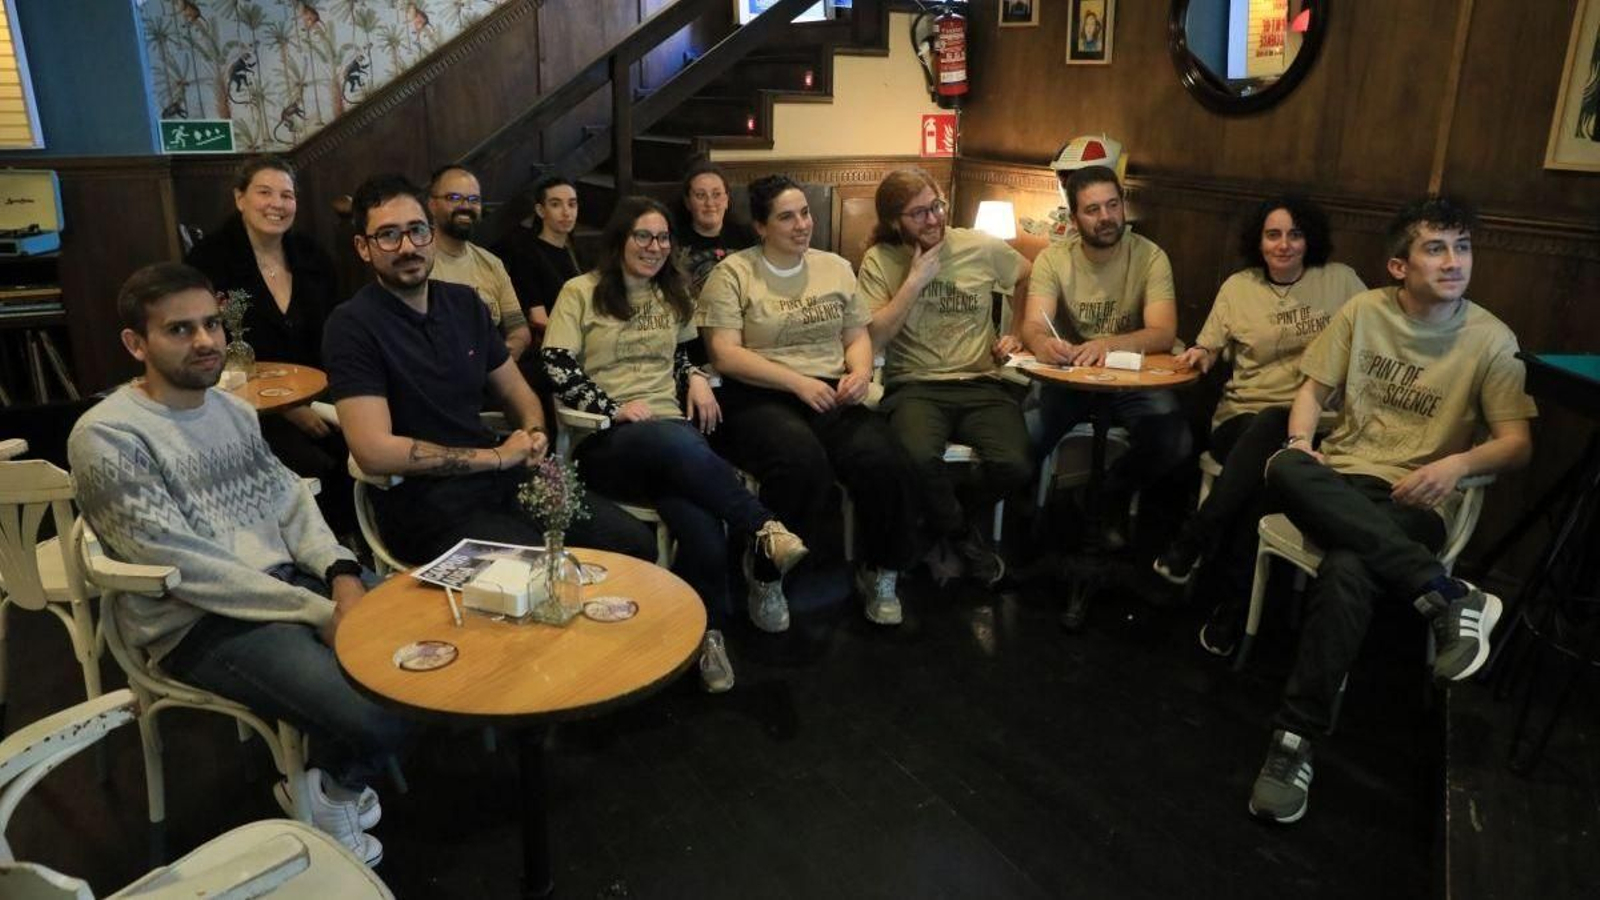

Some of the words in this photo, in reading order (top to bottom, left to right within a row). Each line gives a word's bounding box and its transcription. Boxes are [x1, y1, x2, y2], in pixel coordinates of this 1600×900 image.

[779, 297, 803, 311] PINT
[939, 293, 979, 313] SCIENCE
[1079, 301, 1103, 320] PINT
[1104, 300, 1118, 317] OF
[802, 302, 845, 325] SCIENCE
[1094, 313, 1132, 334] SCIENCE
[1276, 308, 1298, 325] PINT
[1300, 305, 1312, 320] OF
[1367, 355, 1405, 382] PINT
[1400, 364, 1425, 387] OF
[1382, 383, 1442, 418] SCIENCE
